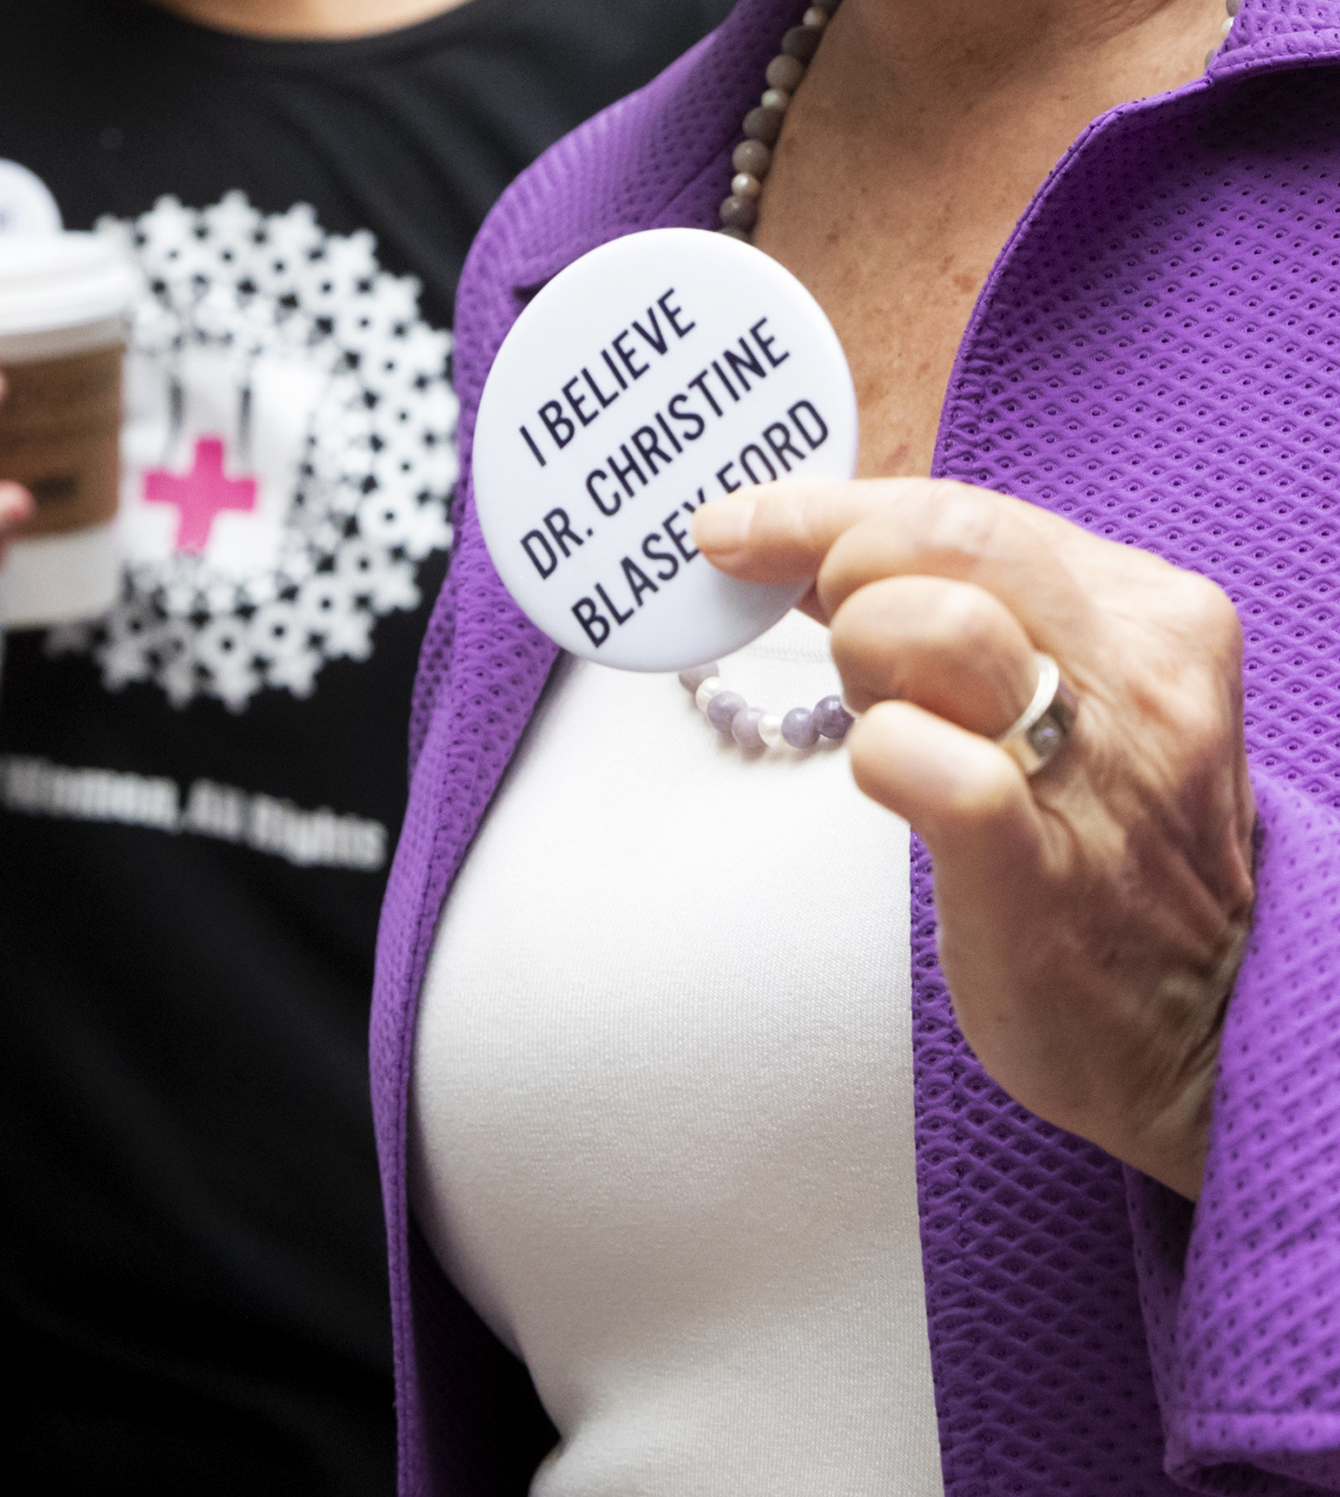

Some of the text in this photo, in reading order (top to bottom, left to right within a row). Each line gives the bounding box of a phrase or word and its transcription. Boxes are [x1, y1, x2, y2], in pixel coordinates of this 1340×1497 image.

[518, 287, 697, 468] I BELIEVE
[520, 317, 791, 581] DR. CHRISTINE
[715, 399, 829, 494] FORD
